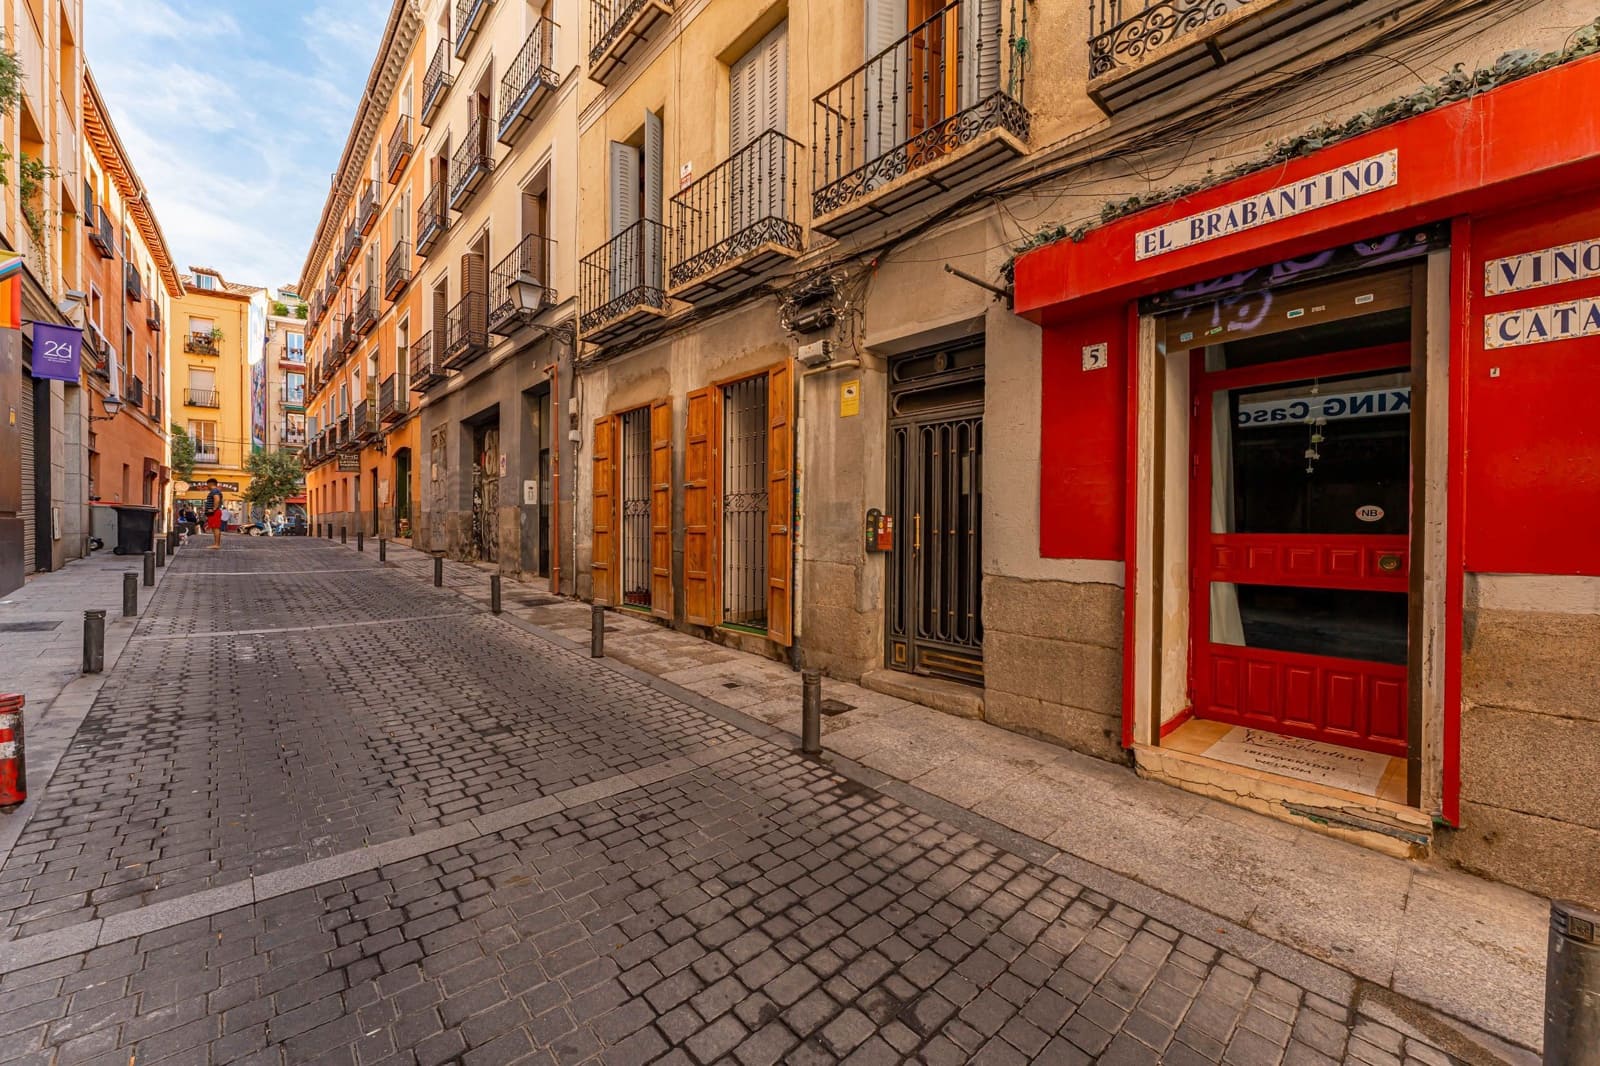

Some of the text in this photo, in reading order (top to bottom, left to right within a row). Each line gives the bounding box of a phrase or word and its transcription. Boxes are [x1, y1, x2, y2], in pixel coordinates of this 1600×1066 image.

[1143, 161, 1384, 253] EL BRABANTINO
[1090, 348, 1099, 365] 5
[1361, 509, 1377, 517] NB
